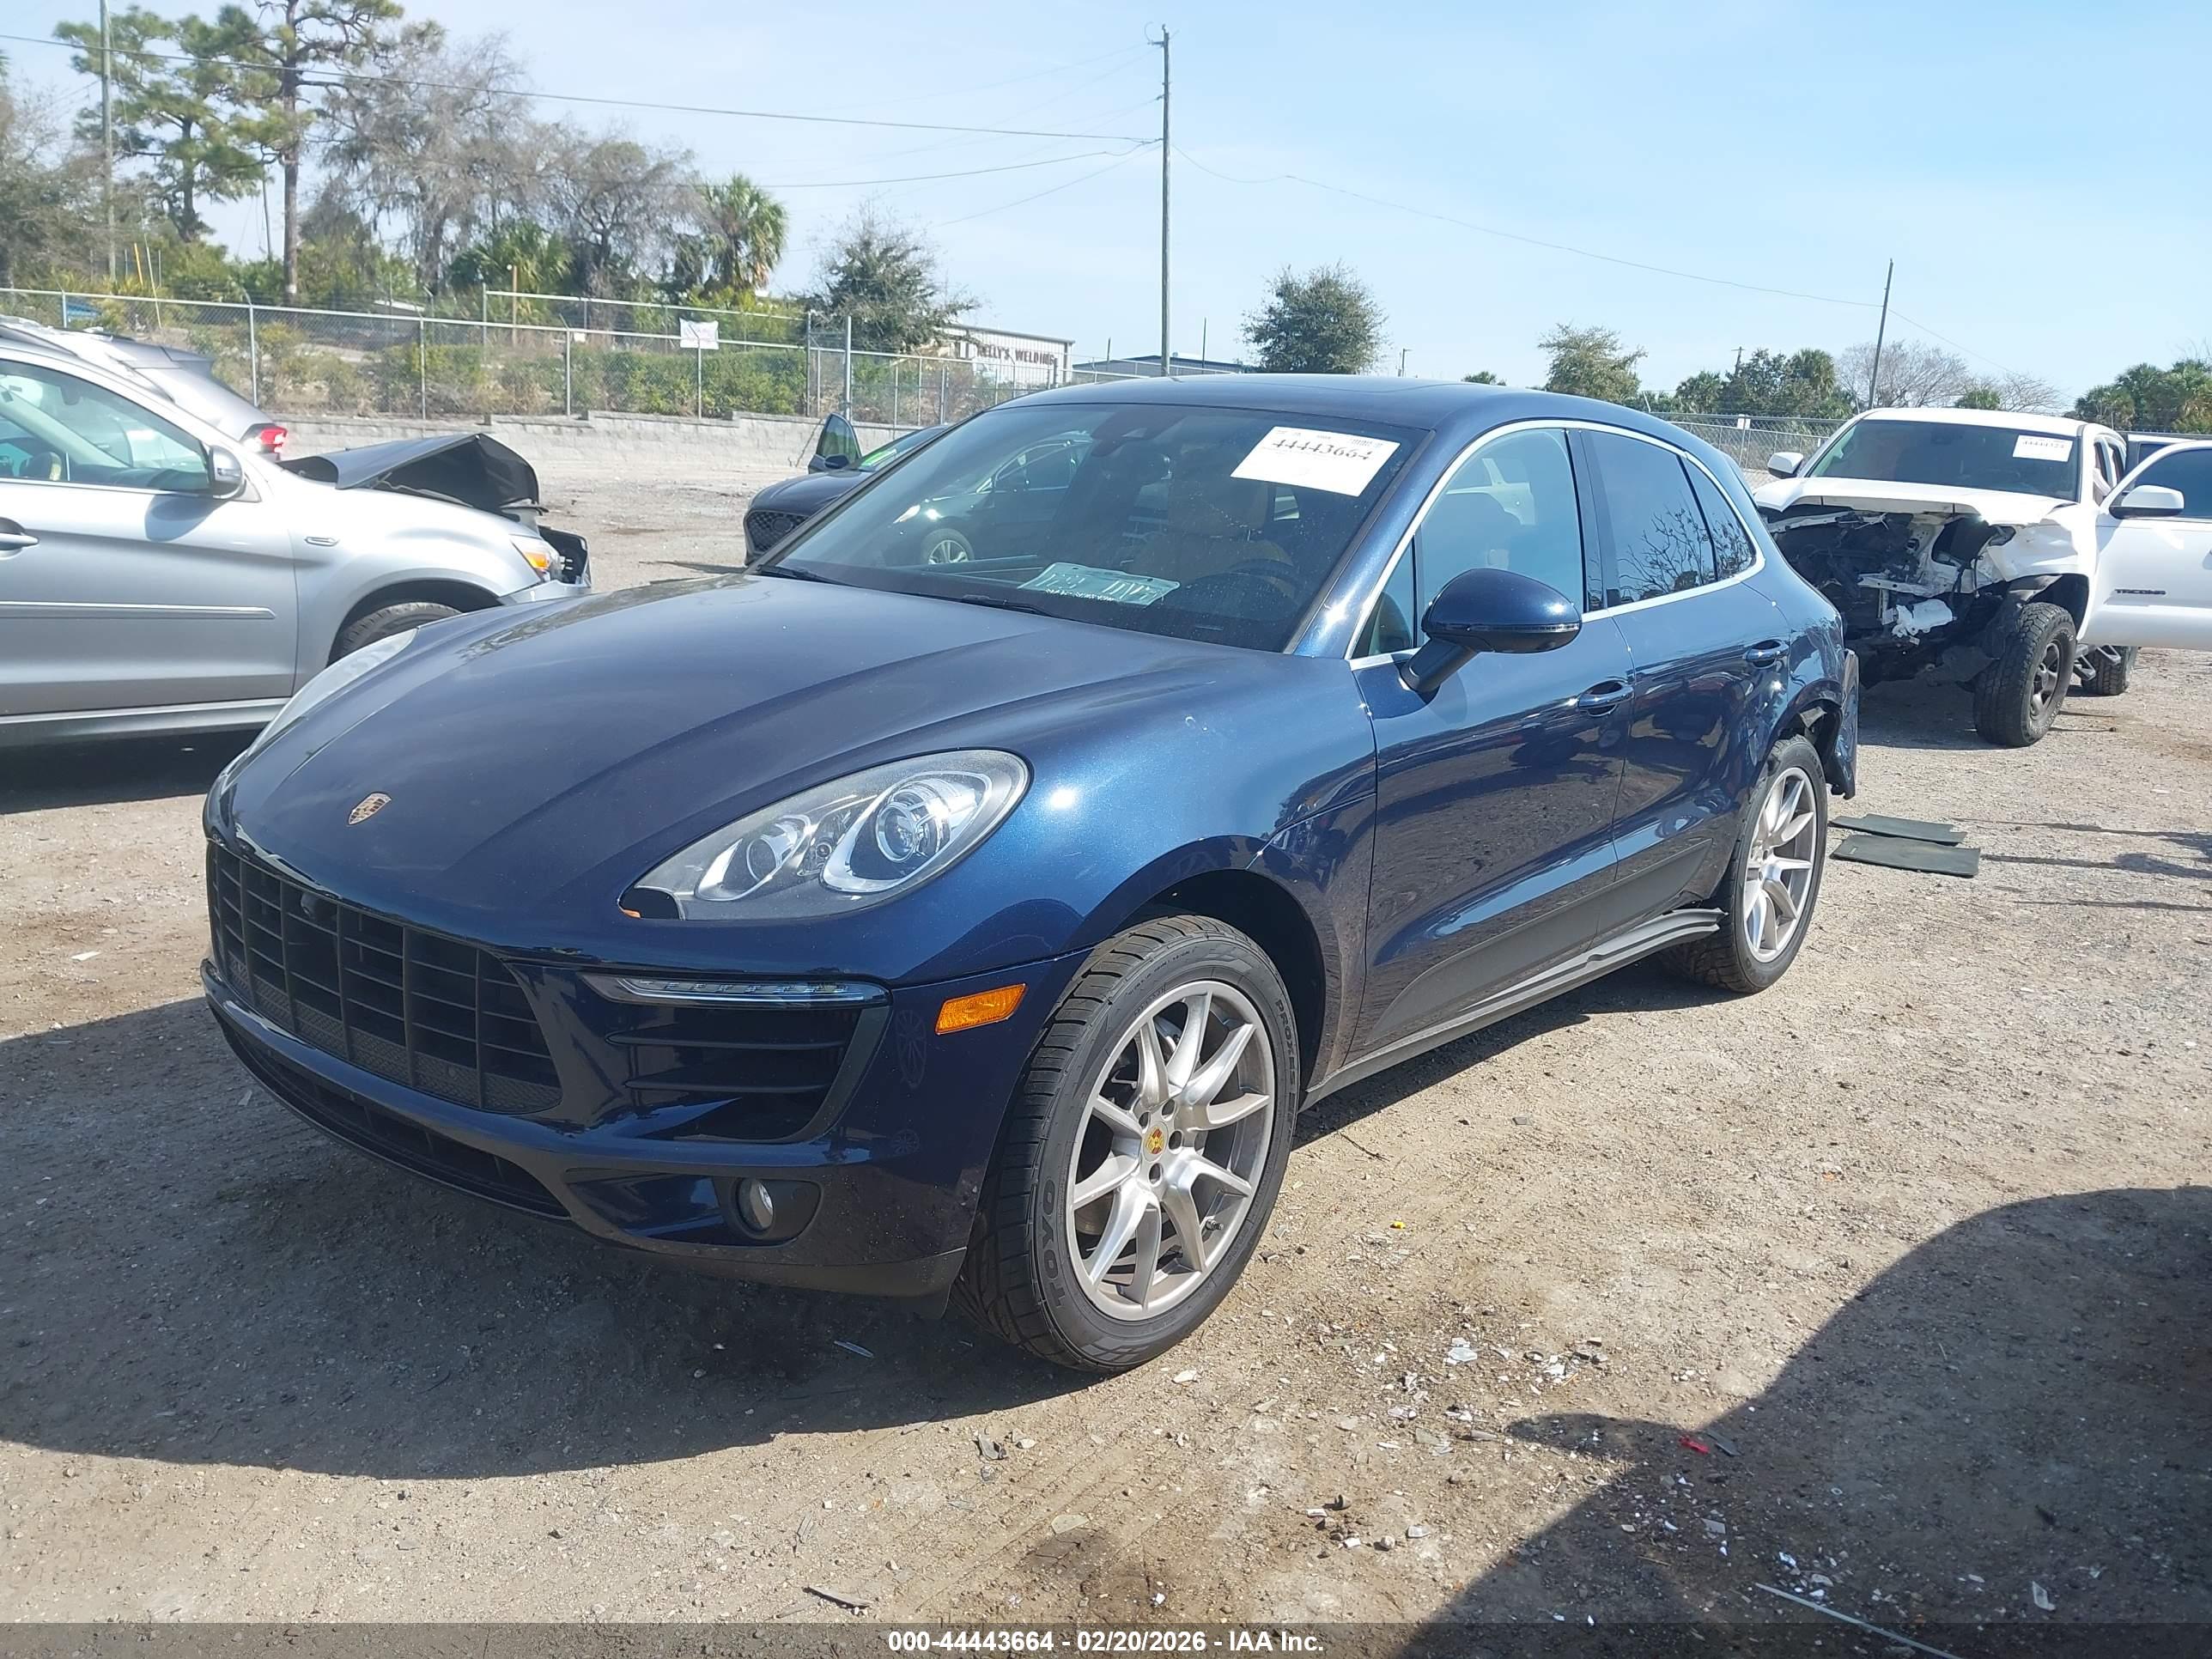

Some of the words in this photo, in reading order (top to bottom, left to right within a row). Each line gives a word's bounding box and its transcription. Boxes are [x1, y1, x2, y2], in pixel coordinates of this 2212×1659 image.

[1015, 349, 1054, 365] WELDING
[1272, 439, 1373, 460] 44443664
[1274, 999, 1297, 1085] PROXES
[1042, 1172, 1066, 1309] TOYO
